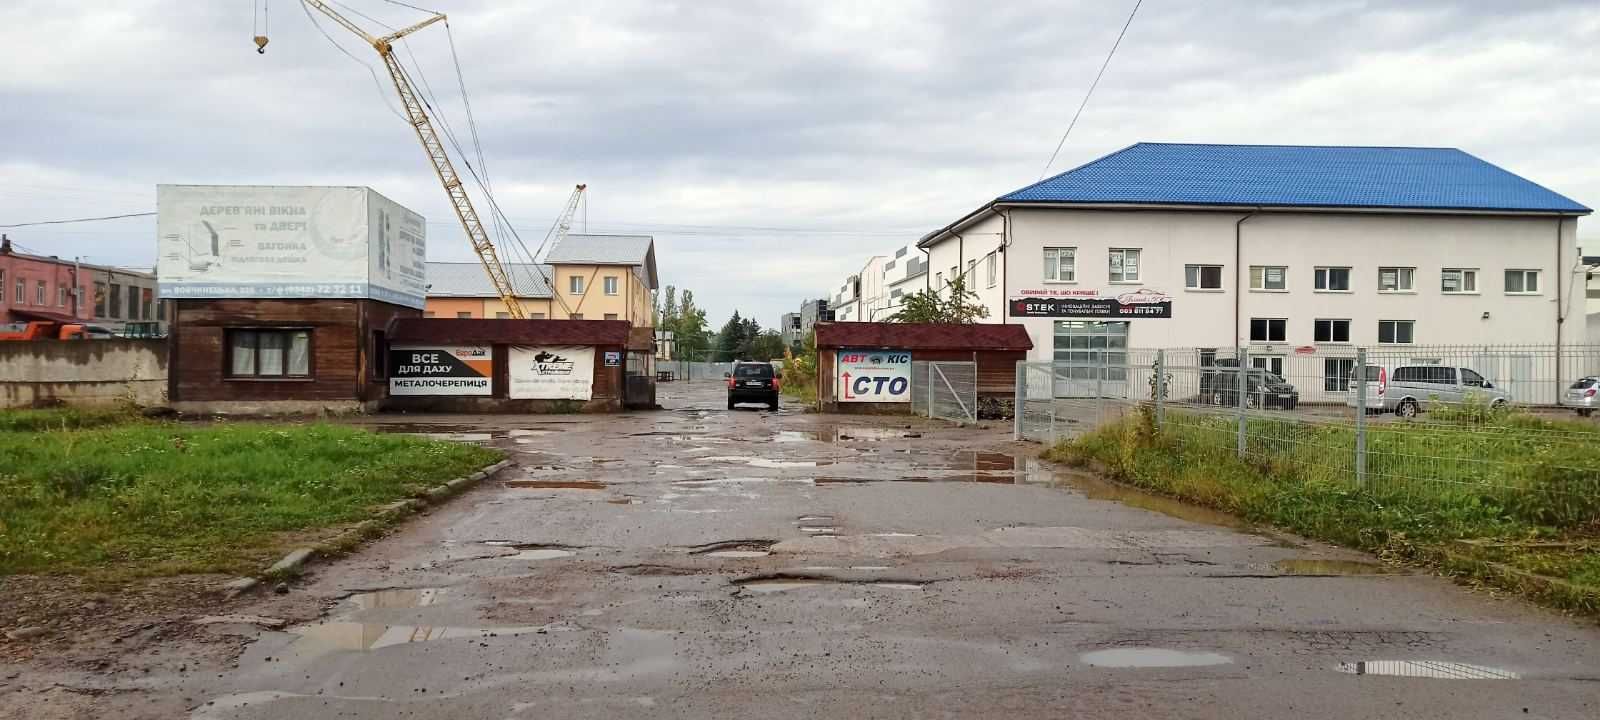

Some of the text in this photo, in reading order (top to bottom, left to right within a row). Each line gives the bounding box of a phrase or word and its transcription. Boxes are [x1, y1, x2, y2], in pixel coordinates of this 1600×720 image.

[269, 206, 307, 216] ВІКНА
[269, 222, 307, 232] ДВЕРІ
[412, 353, 440, 364] ВСЕ
[398, 366, 453, 375] ДЛЯ ДАХУ
[394, 380, 488, 388] МЕТАЛОЧЕРЕПИЦЯ
[853, 376, 908, 395] СТО
